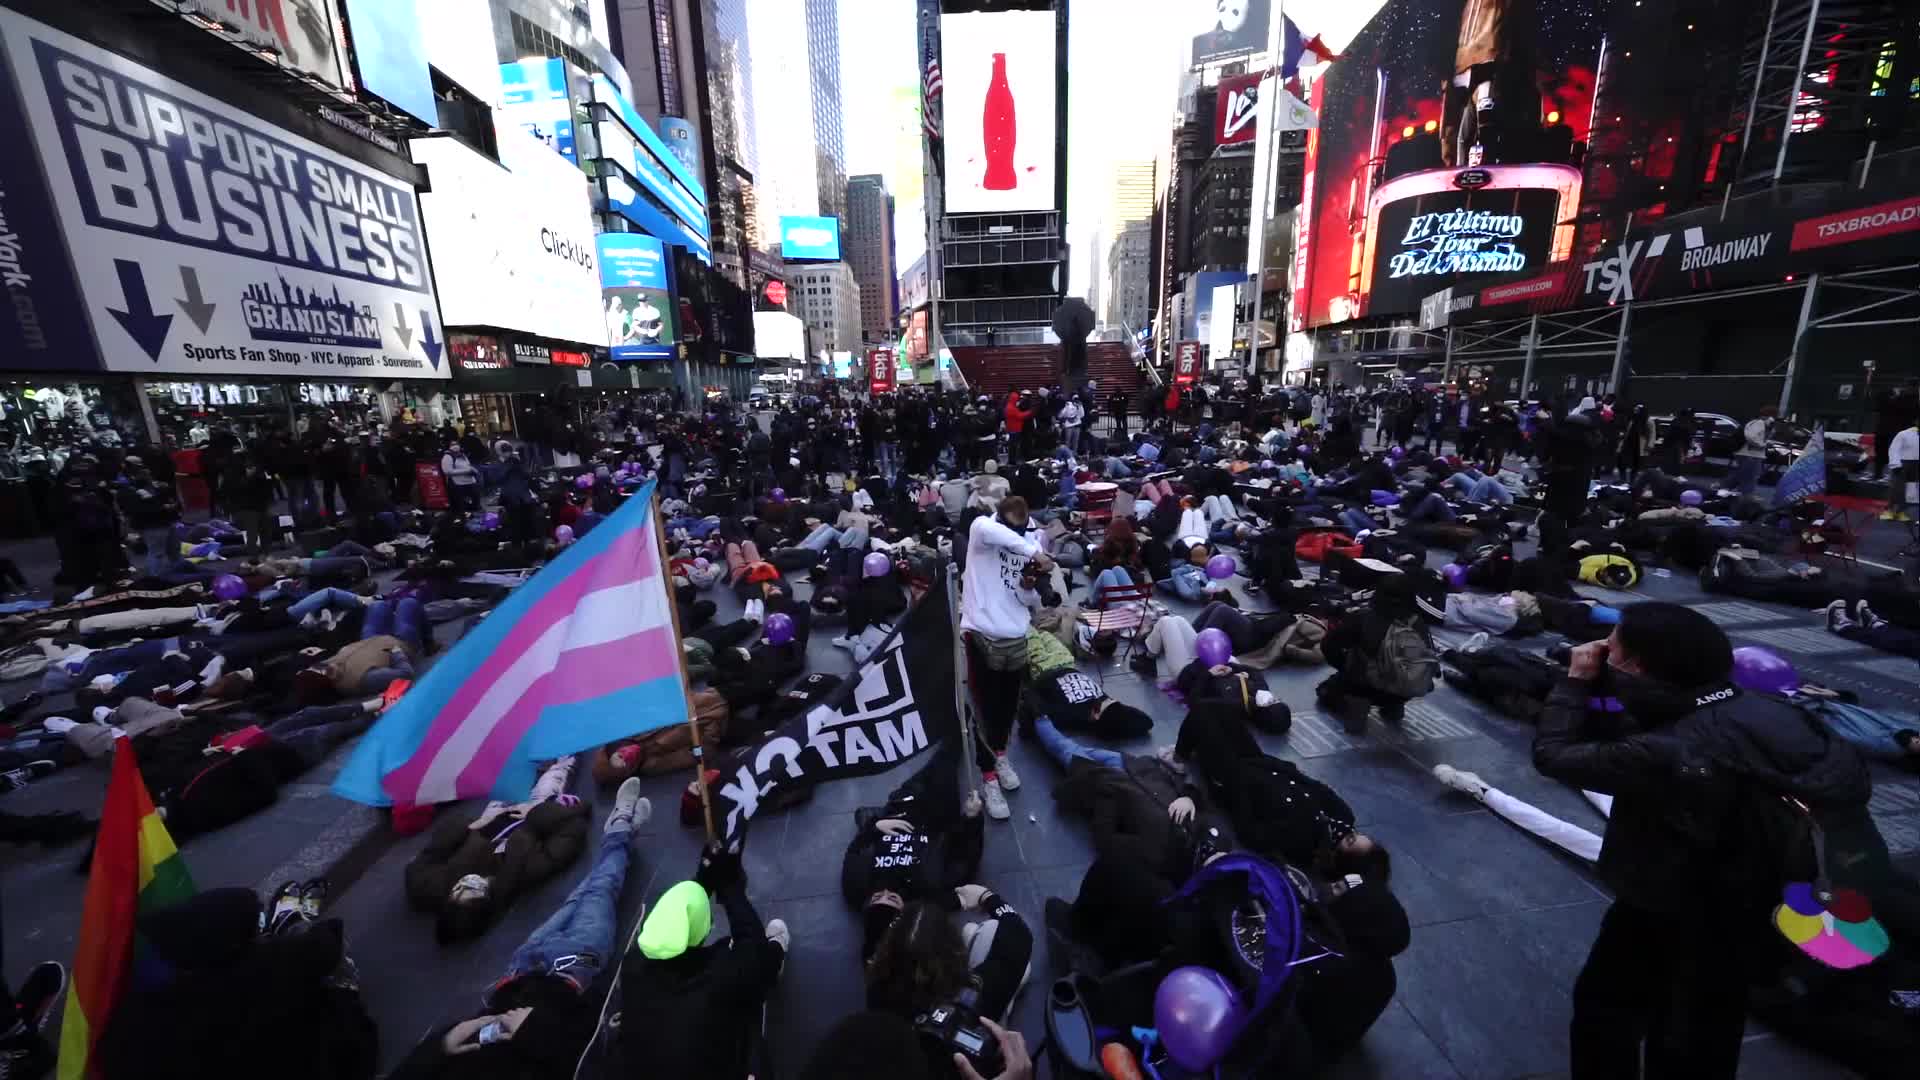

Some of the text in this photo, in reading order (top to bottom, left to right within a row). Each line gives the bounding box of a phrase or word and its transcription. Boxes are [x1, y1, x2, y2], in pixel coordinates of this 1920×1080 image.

[56, 59, 413, 229] SUPPORT SMALL
[74, 123, 422, 287] BUSINESS
[1402, 213, 1434, 244] El
[1818, 207, 1920, 238] TSXBROAD
[541, 227, 592, 272] ClickUp
[1431, 234, 1492, 252] Tour
[1390, 243, 1526, 278] Del Mundo
[1583, 232, 1771, 304] TSX BROADWAY
[246, 300, 382, 339] GRAND SLAM
[183, 343, 423, 368] Sports Fan Shop NYC Apparel Souvenirs
[537, 345, 550, 357] FIN
[1181, 344, 1196, 373] tkts
[170, 383, 259, 405] GRAND
[1696, 688, 1734, 706] SONY
